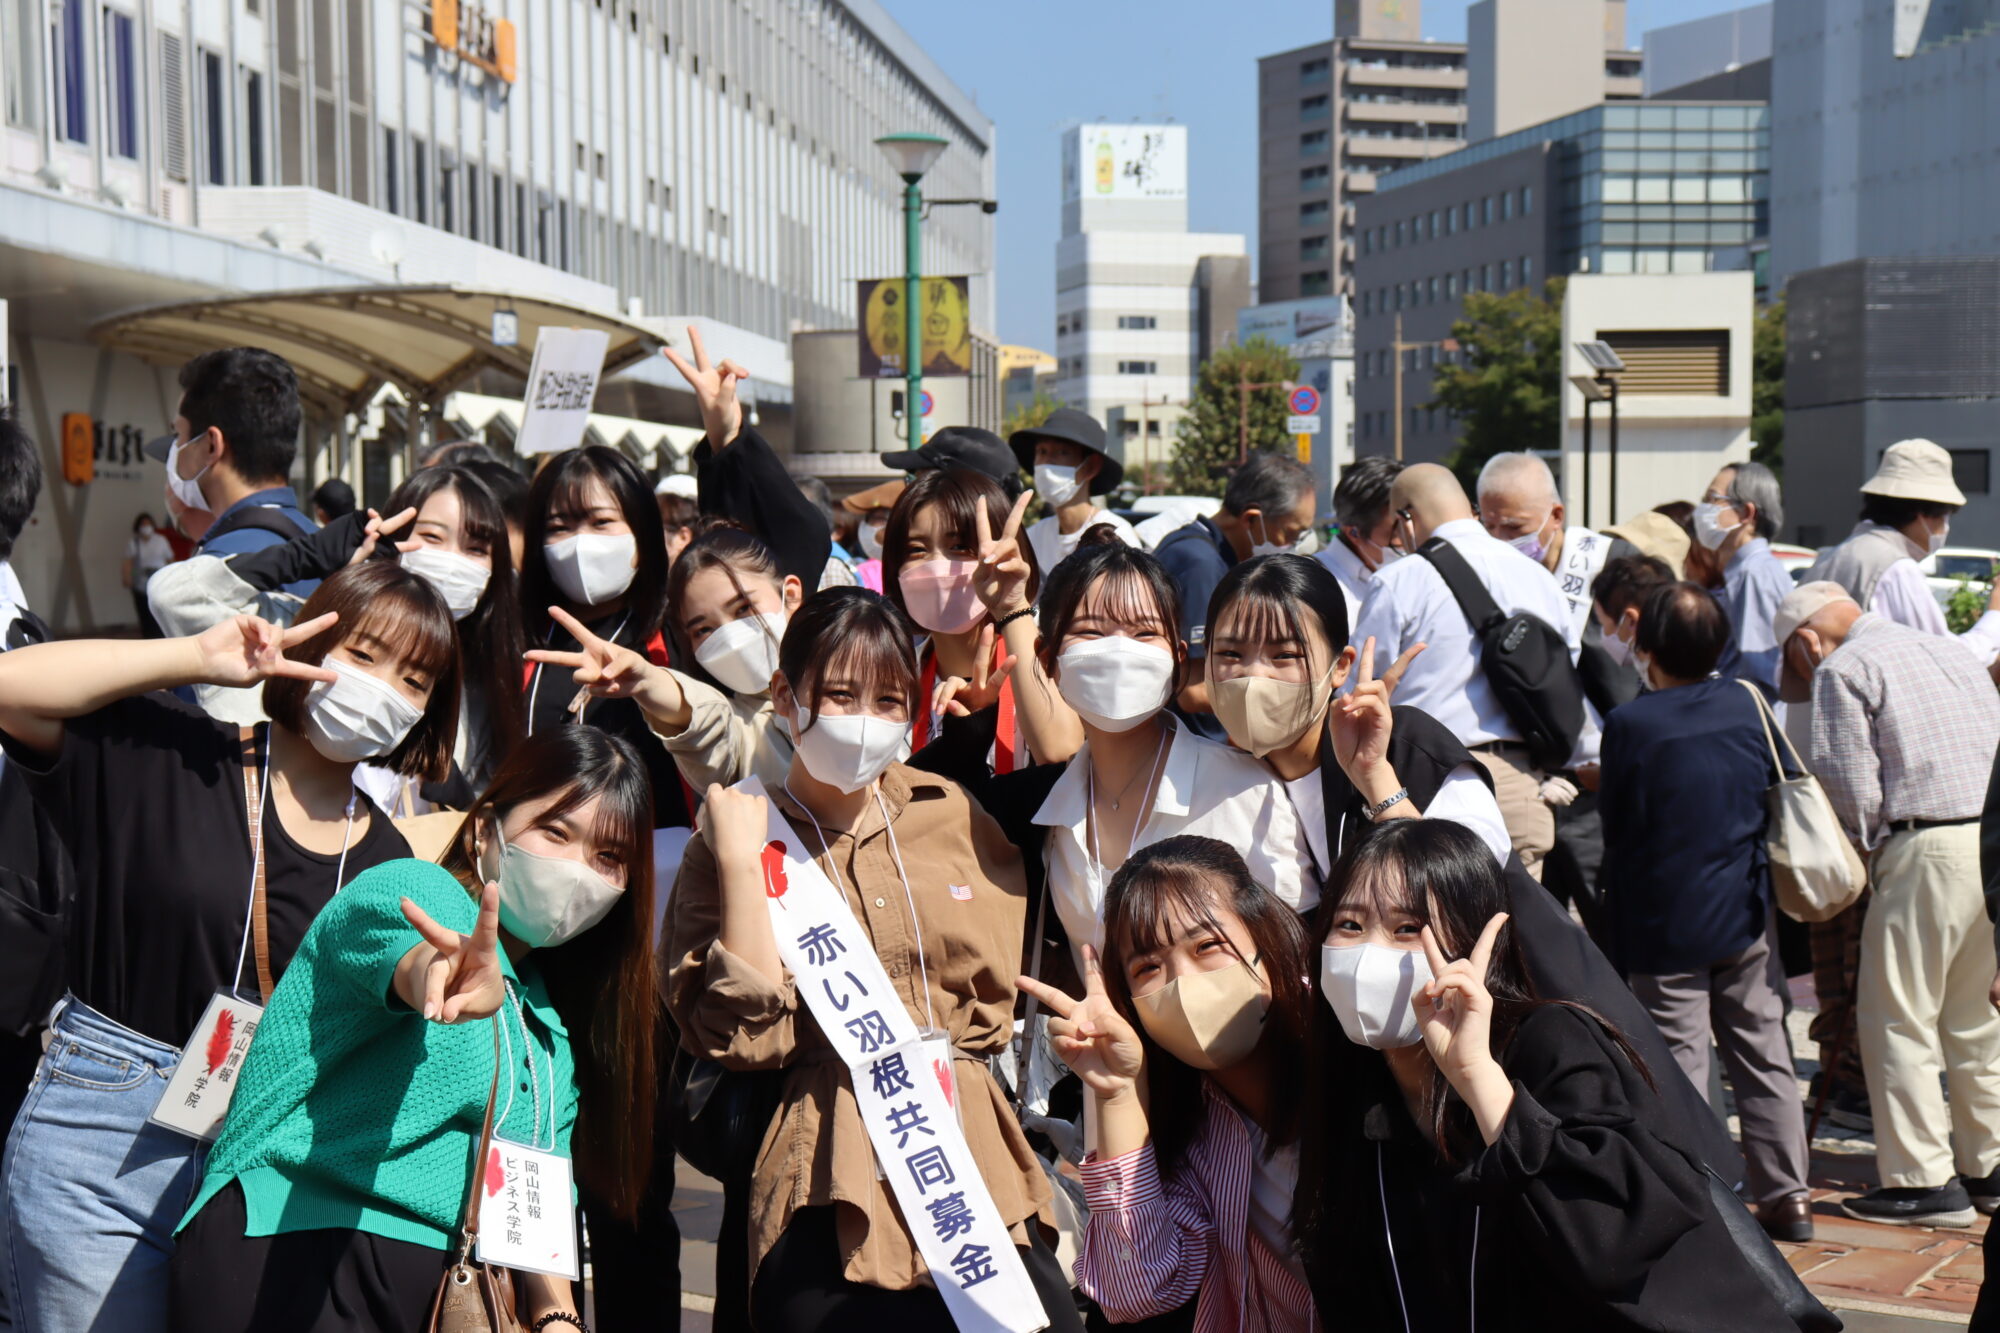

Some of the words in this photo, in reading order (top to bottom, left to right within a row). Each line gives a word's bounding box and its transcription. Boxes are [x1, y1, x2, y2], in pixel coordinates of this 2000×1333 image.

[796, 921, 999, 1290] 赤い羽根共同募金
[505, 1156, 523, 1246] ビジネス学院
[524, 1159, 542, 1220] 岡山情報
